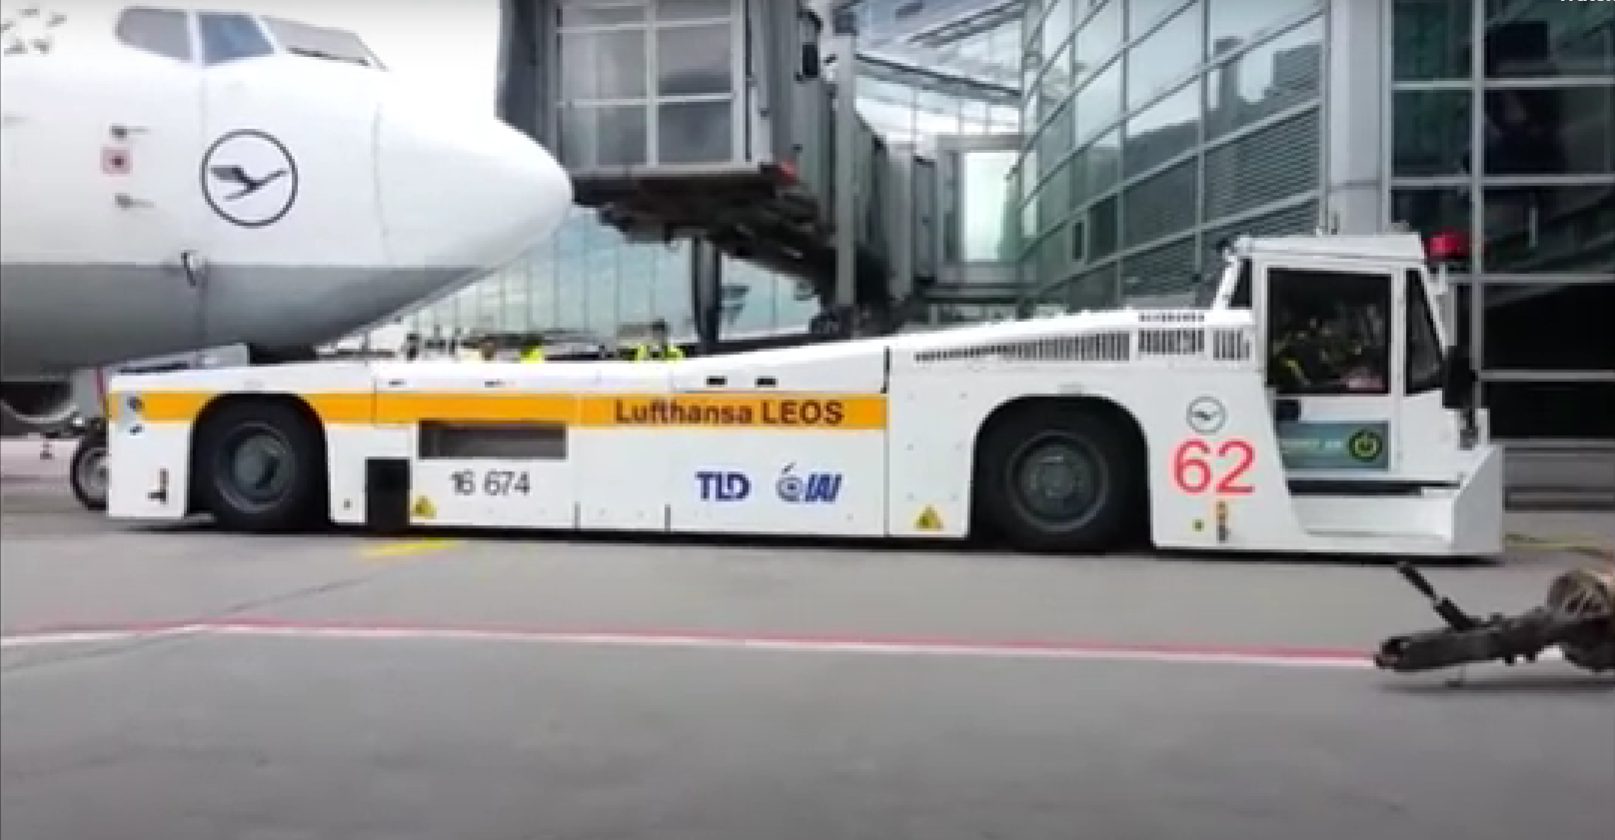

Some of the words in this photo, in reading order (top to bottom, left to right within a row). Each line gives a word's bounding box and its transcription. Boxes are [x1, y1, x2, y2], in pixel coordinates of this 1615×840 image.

[615, 399, 752, 425] Lufthansa
[761, 400, 843, 425] LEOS
[1174, 440, 1256, 494] 62
[451, 470, 475, 495] 16
[483, 470, 531, 496] 674
[695, 471, 750, 502] TLD
